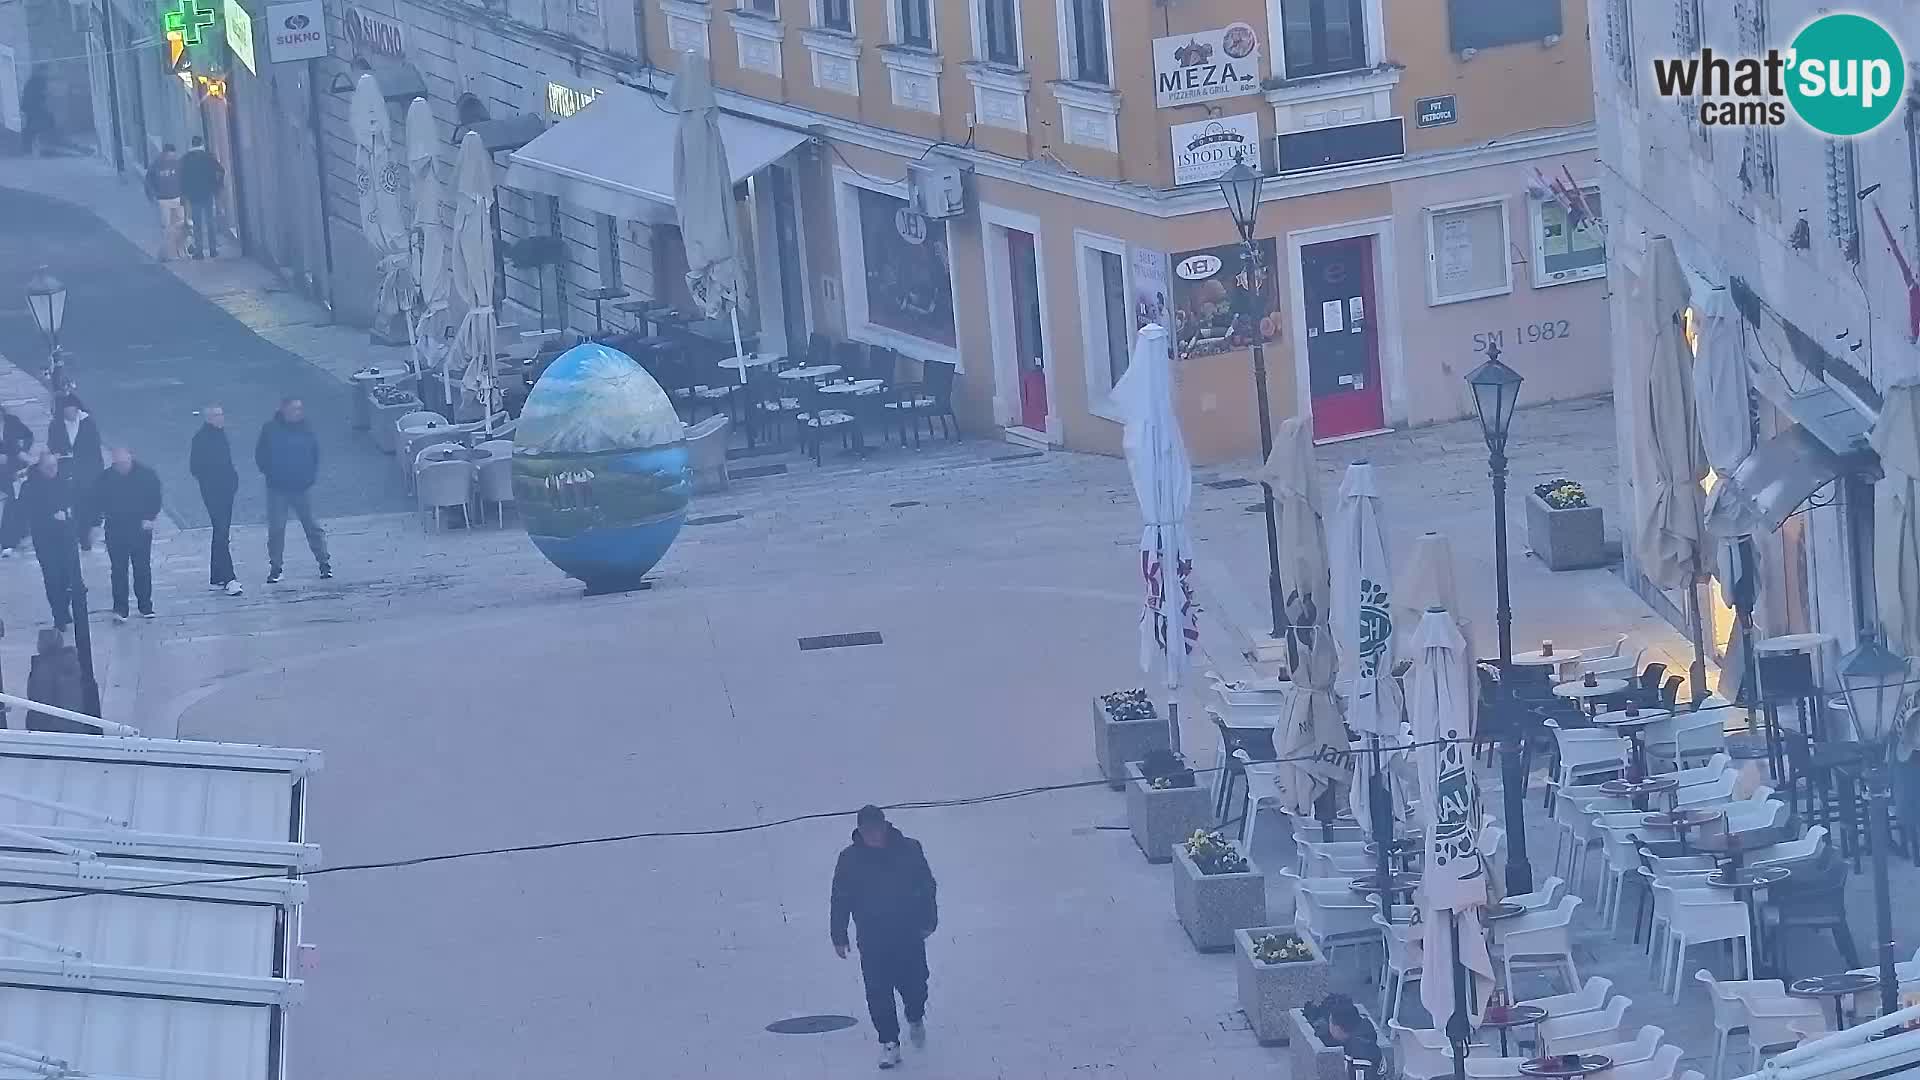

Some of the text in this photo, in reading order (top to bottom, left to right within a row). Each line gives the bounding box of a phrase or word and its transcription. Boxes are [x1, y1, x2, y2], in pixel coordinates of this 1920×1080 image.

[276, 31, 320, 45] SUKNO
[362, 15, 403, 56] SUKNO
[1159, 62, 1238, 93] MEZA
[1168, 87, 1201, 101] PIZZERIA
[1209, 84, 1230, 95] GRILL
[1178, 148, 1223, 167] ISPOD
[1516, 319, 1570, 345] 1982
